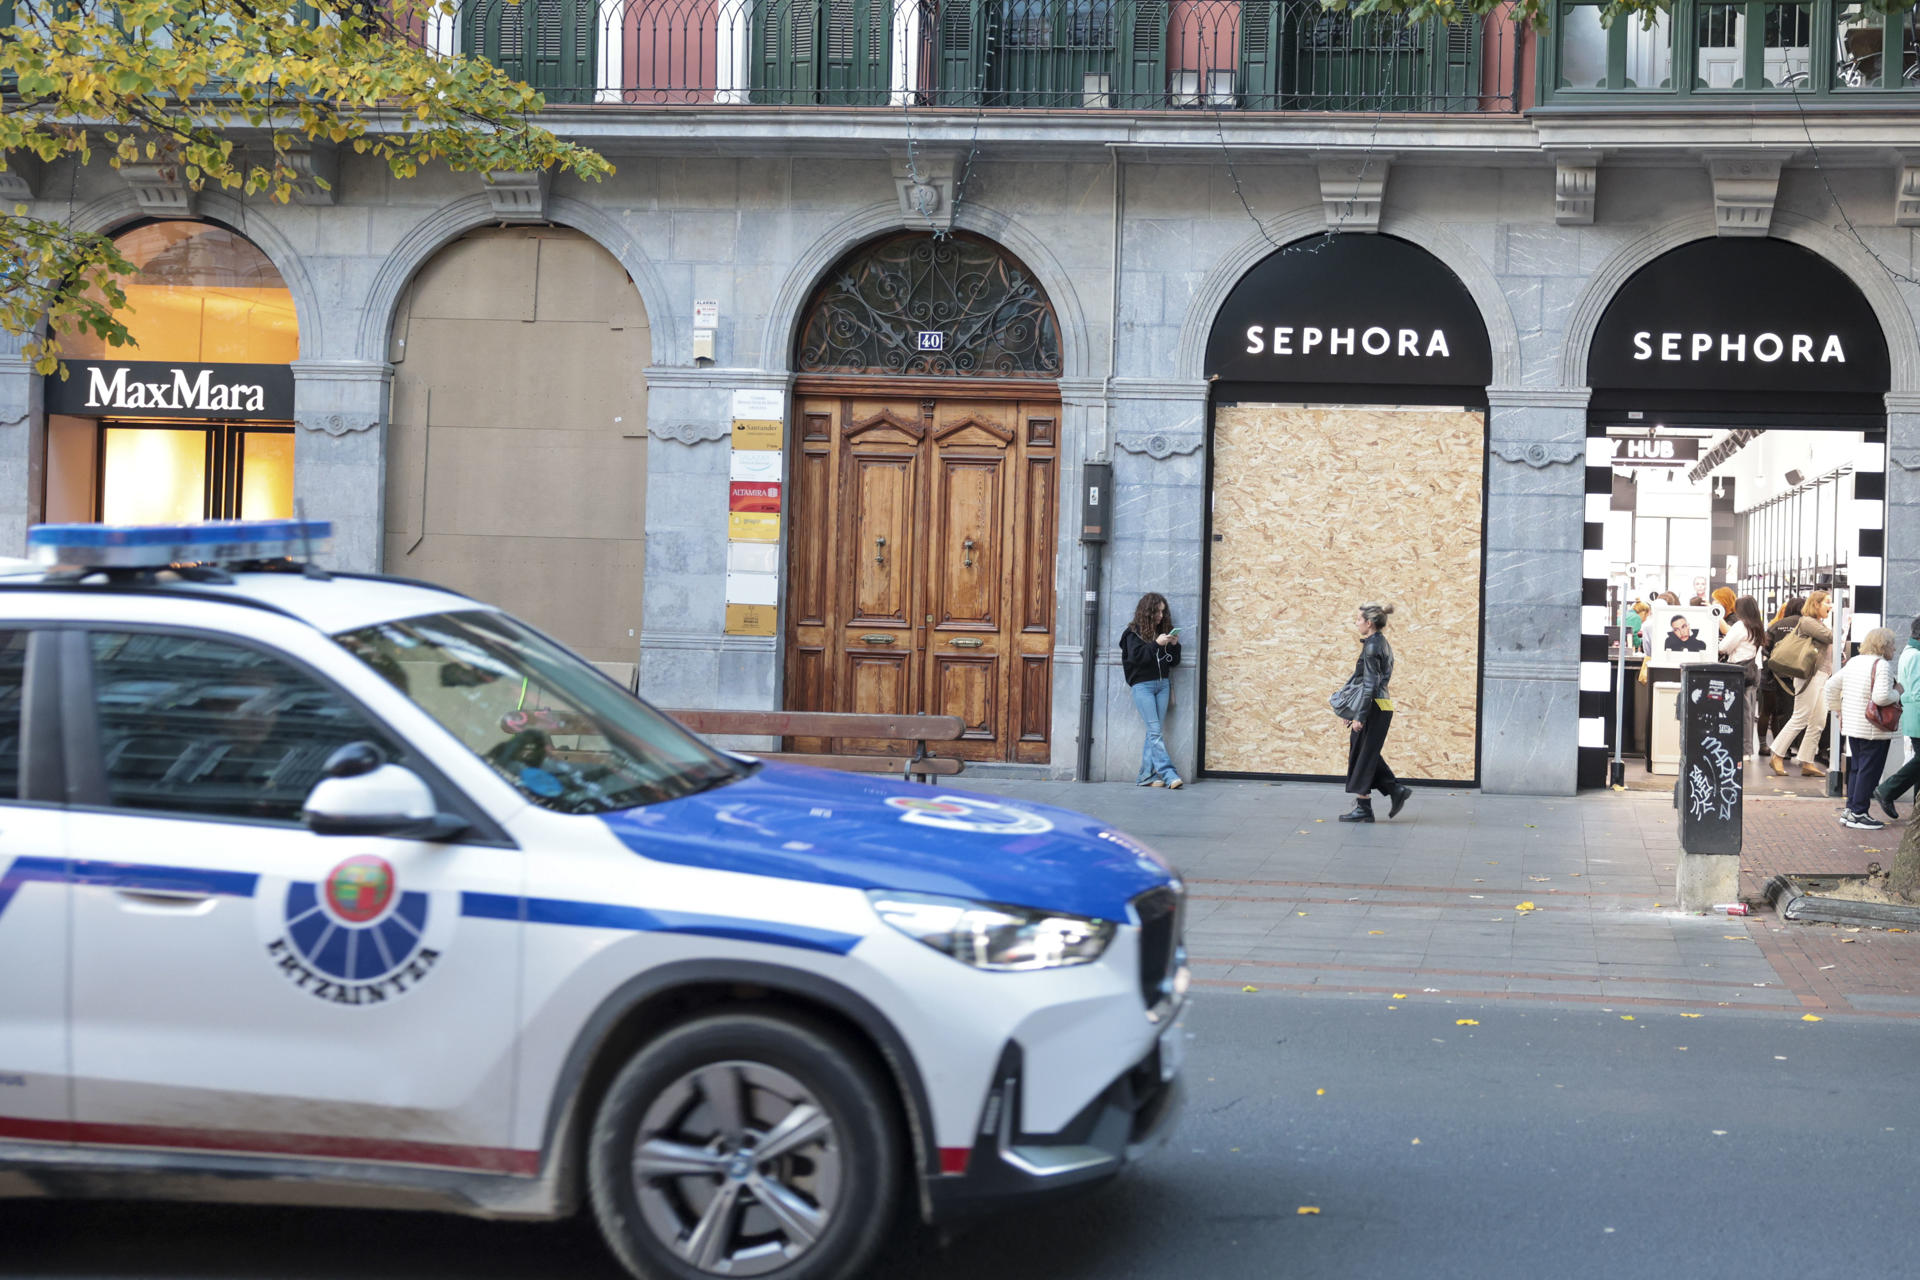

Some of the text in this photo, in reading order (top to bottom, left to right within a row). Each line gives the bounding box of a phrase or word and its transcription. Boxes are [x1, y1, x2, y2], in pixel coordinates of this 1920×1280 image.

[921, 334, 940, 348] 40
[1246, 325, 1450, 357] SEPHORA
[1633, 331, 1846, 363] SEPHORA
[84, 367, 265, 411] MaxMara
[1628, 440, 1675, 458] HUB
[733, 488, 767, 497] ALTAMIRA
[267, 937, 441, 1006] ERTZAINTZA
